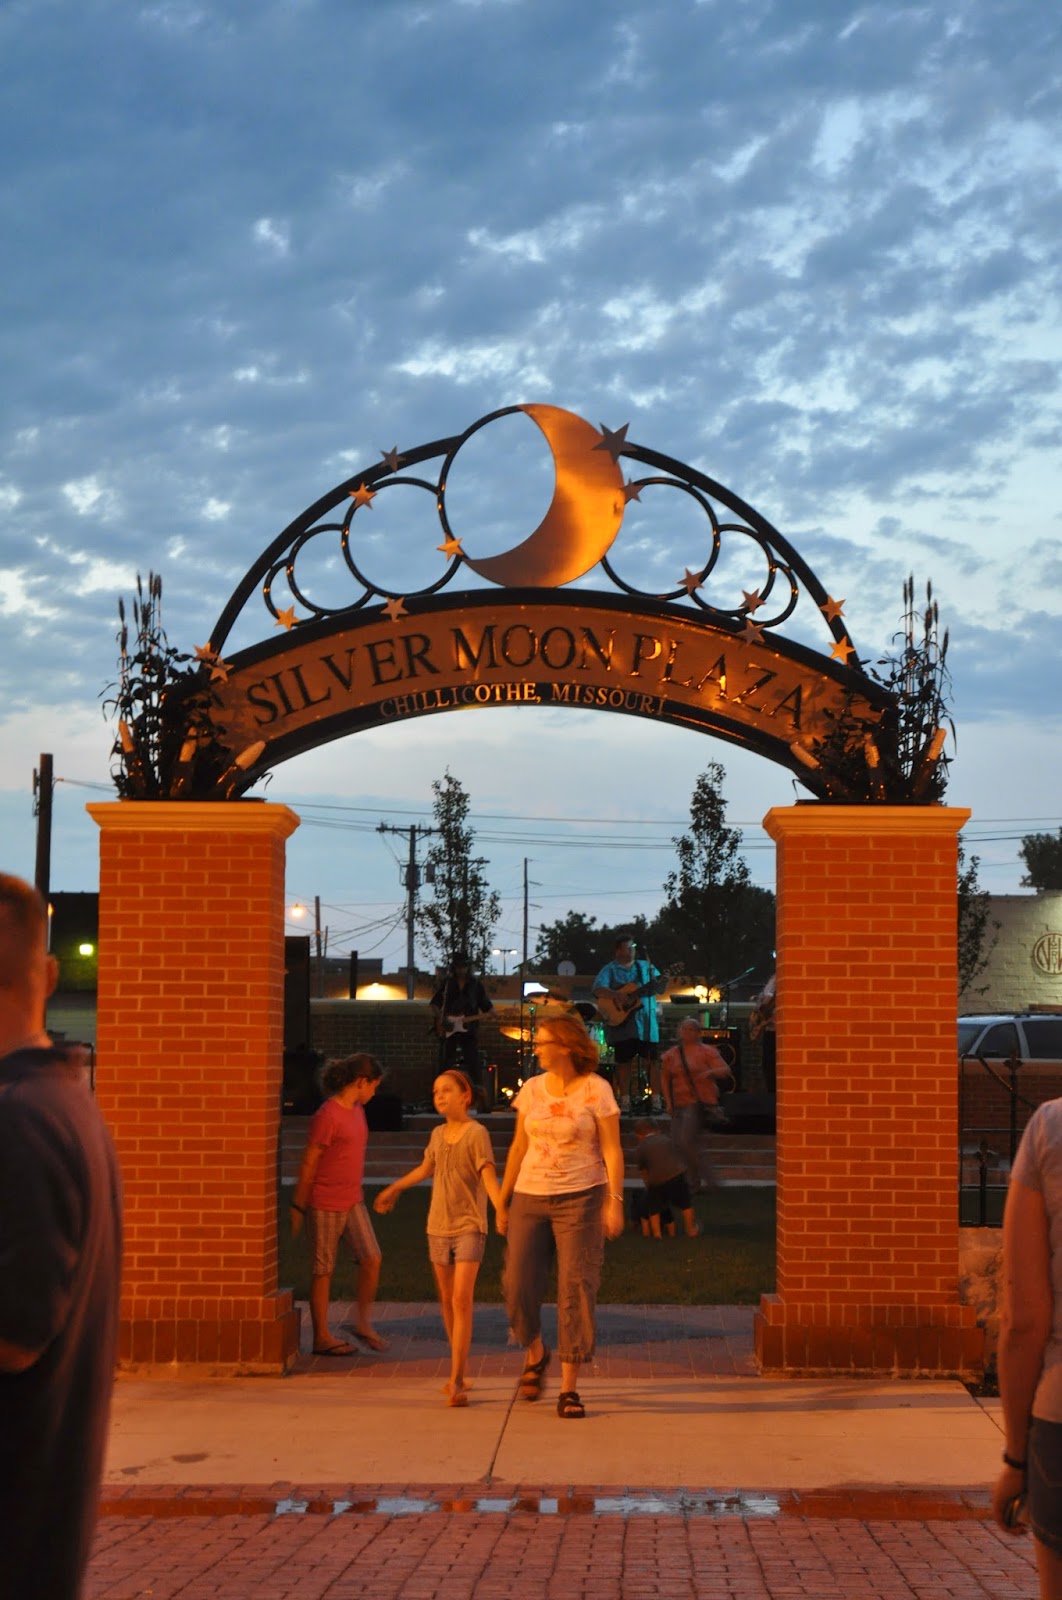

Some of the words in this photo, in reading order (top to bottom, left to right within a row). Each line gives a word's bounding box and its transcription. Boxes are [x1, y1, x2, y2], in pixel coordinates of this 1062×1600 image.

[247, 634, 439, 725] SILVER
[450, 624, 617, 672] MOON
[630, 633, 802, 730] PLAZA
[380, 683, 541, 717] CHILLICOTHE,
[551, 684, 666, 716] MISSOURI
